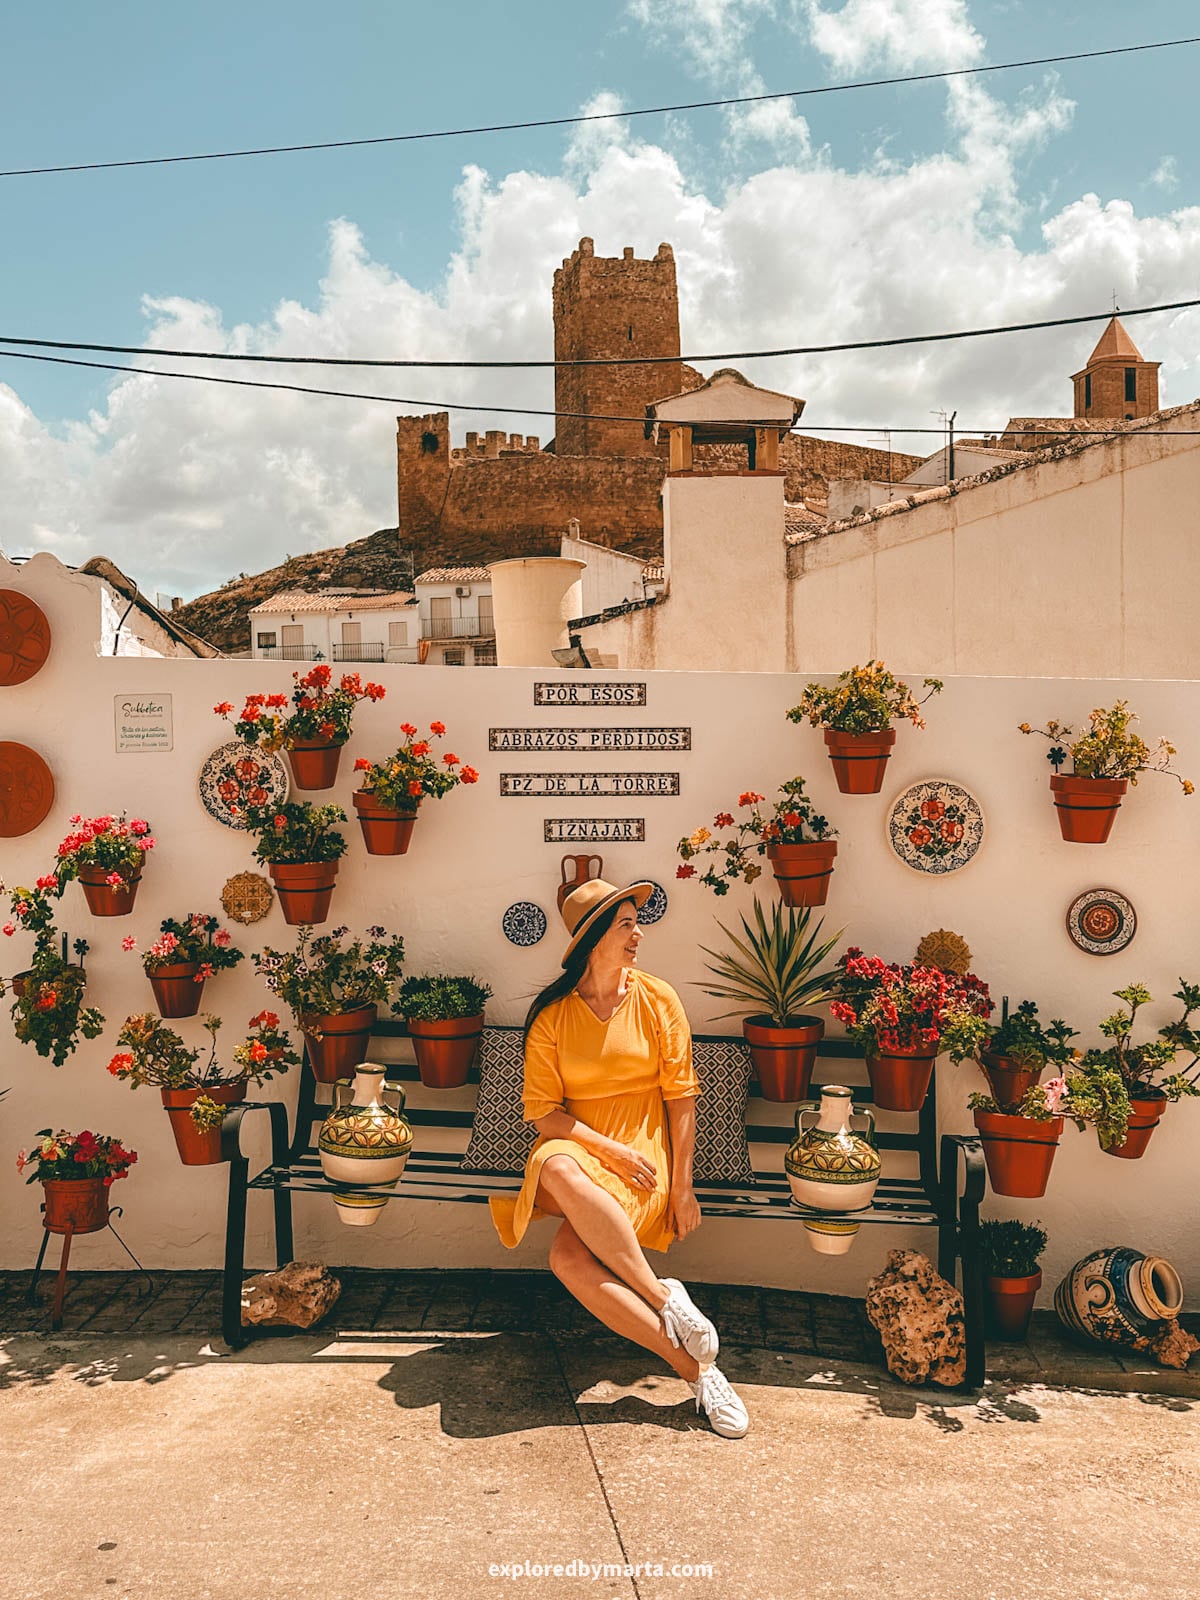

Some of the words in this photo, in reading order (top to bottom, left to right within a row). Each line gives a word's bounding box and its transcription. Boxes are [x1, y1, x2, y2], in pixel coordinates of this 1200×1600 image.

[546, 688, 578, 701] POR
[591, 688, 634, 701] ESOS
[501, 733, 578, 746] ABRAZOS
[590, 733, 680, 745] PERDIDOS
[512, 778, 533, 791] PZ
[545, 778, 566, 791] DE
[579, 778, 600, 791] LA
[612, 778, 668, 790] TORRE
[557, 824, 633, 837] IZNAJAR
